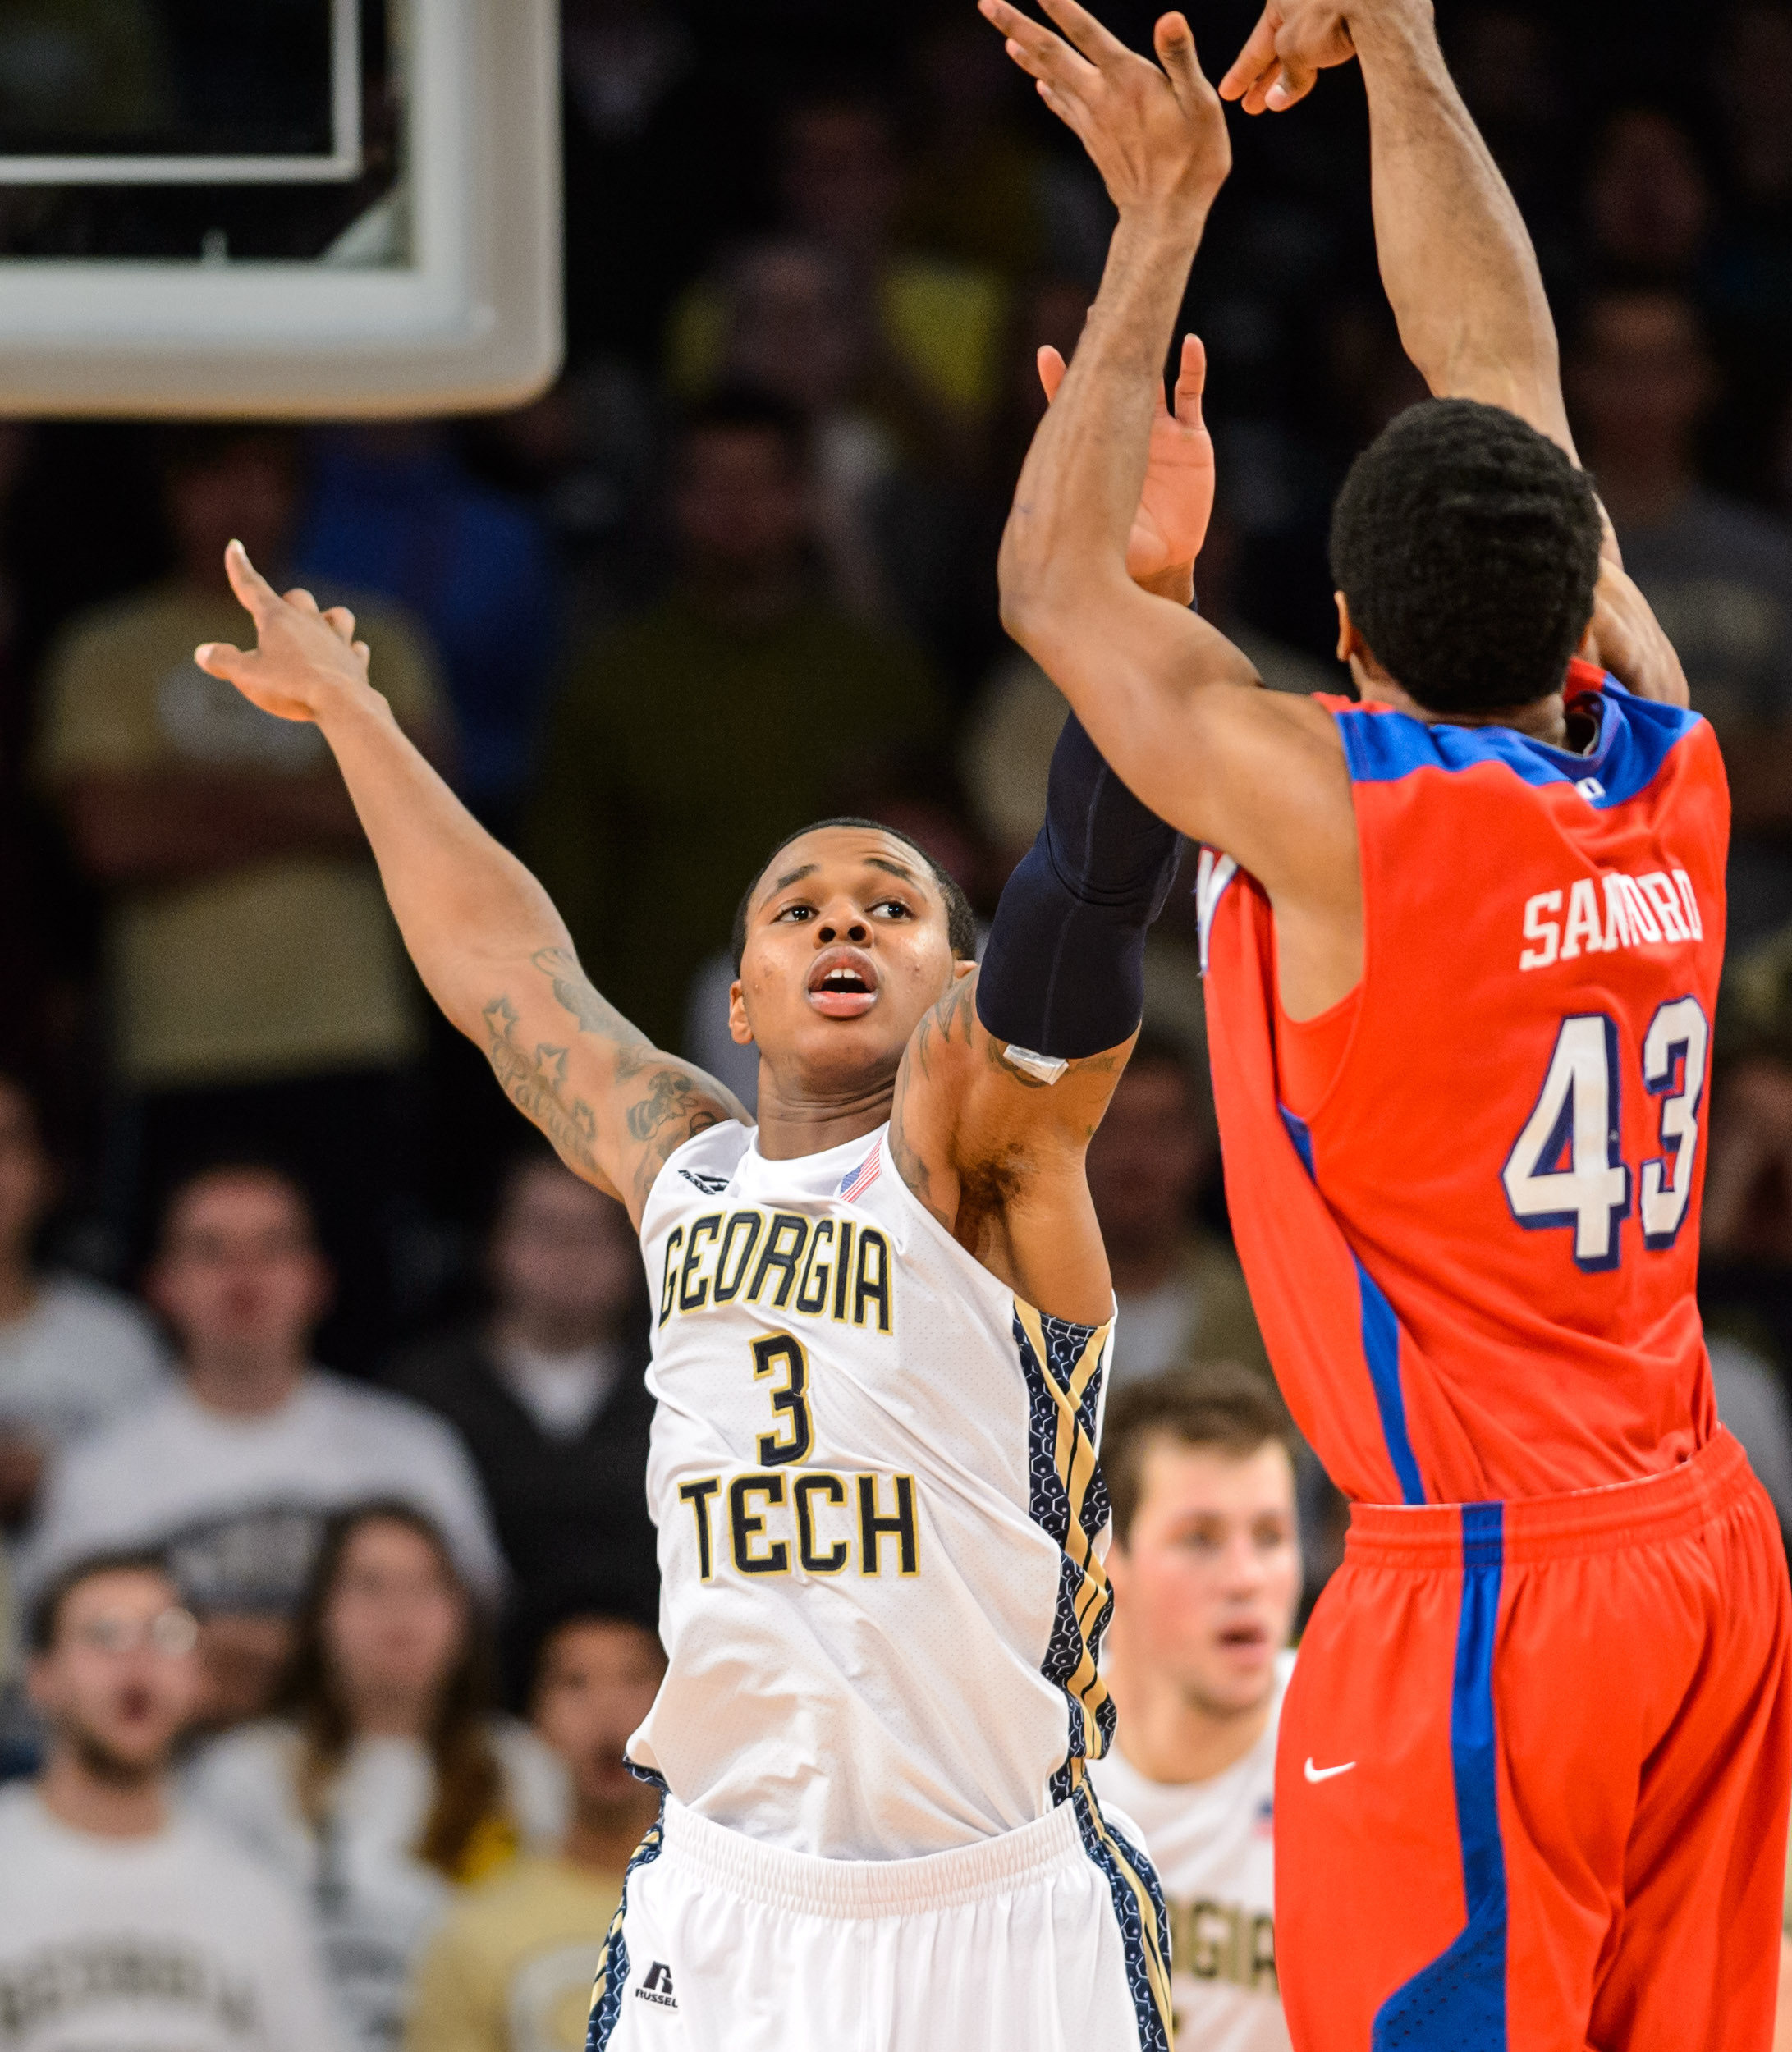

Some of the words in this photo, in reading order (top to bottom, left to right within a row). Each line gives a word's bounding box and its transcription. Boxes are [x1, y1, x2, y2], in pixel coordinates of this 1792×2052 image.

[1499, 993, 1709, 1274] 43
[658, 1210, 894, 1336] GEORGIA
[748, 1329, 815, 1468] 3
[677, 1470, 921, 1583] TECH
